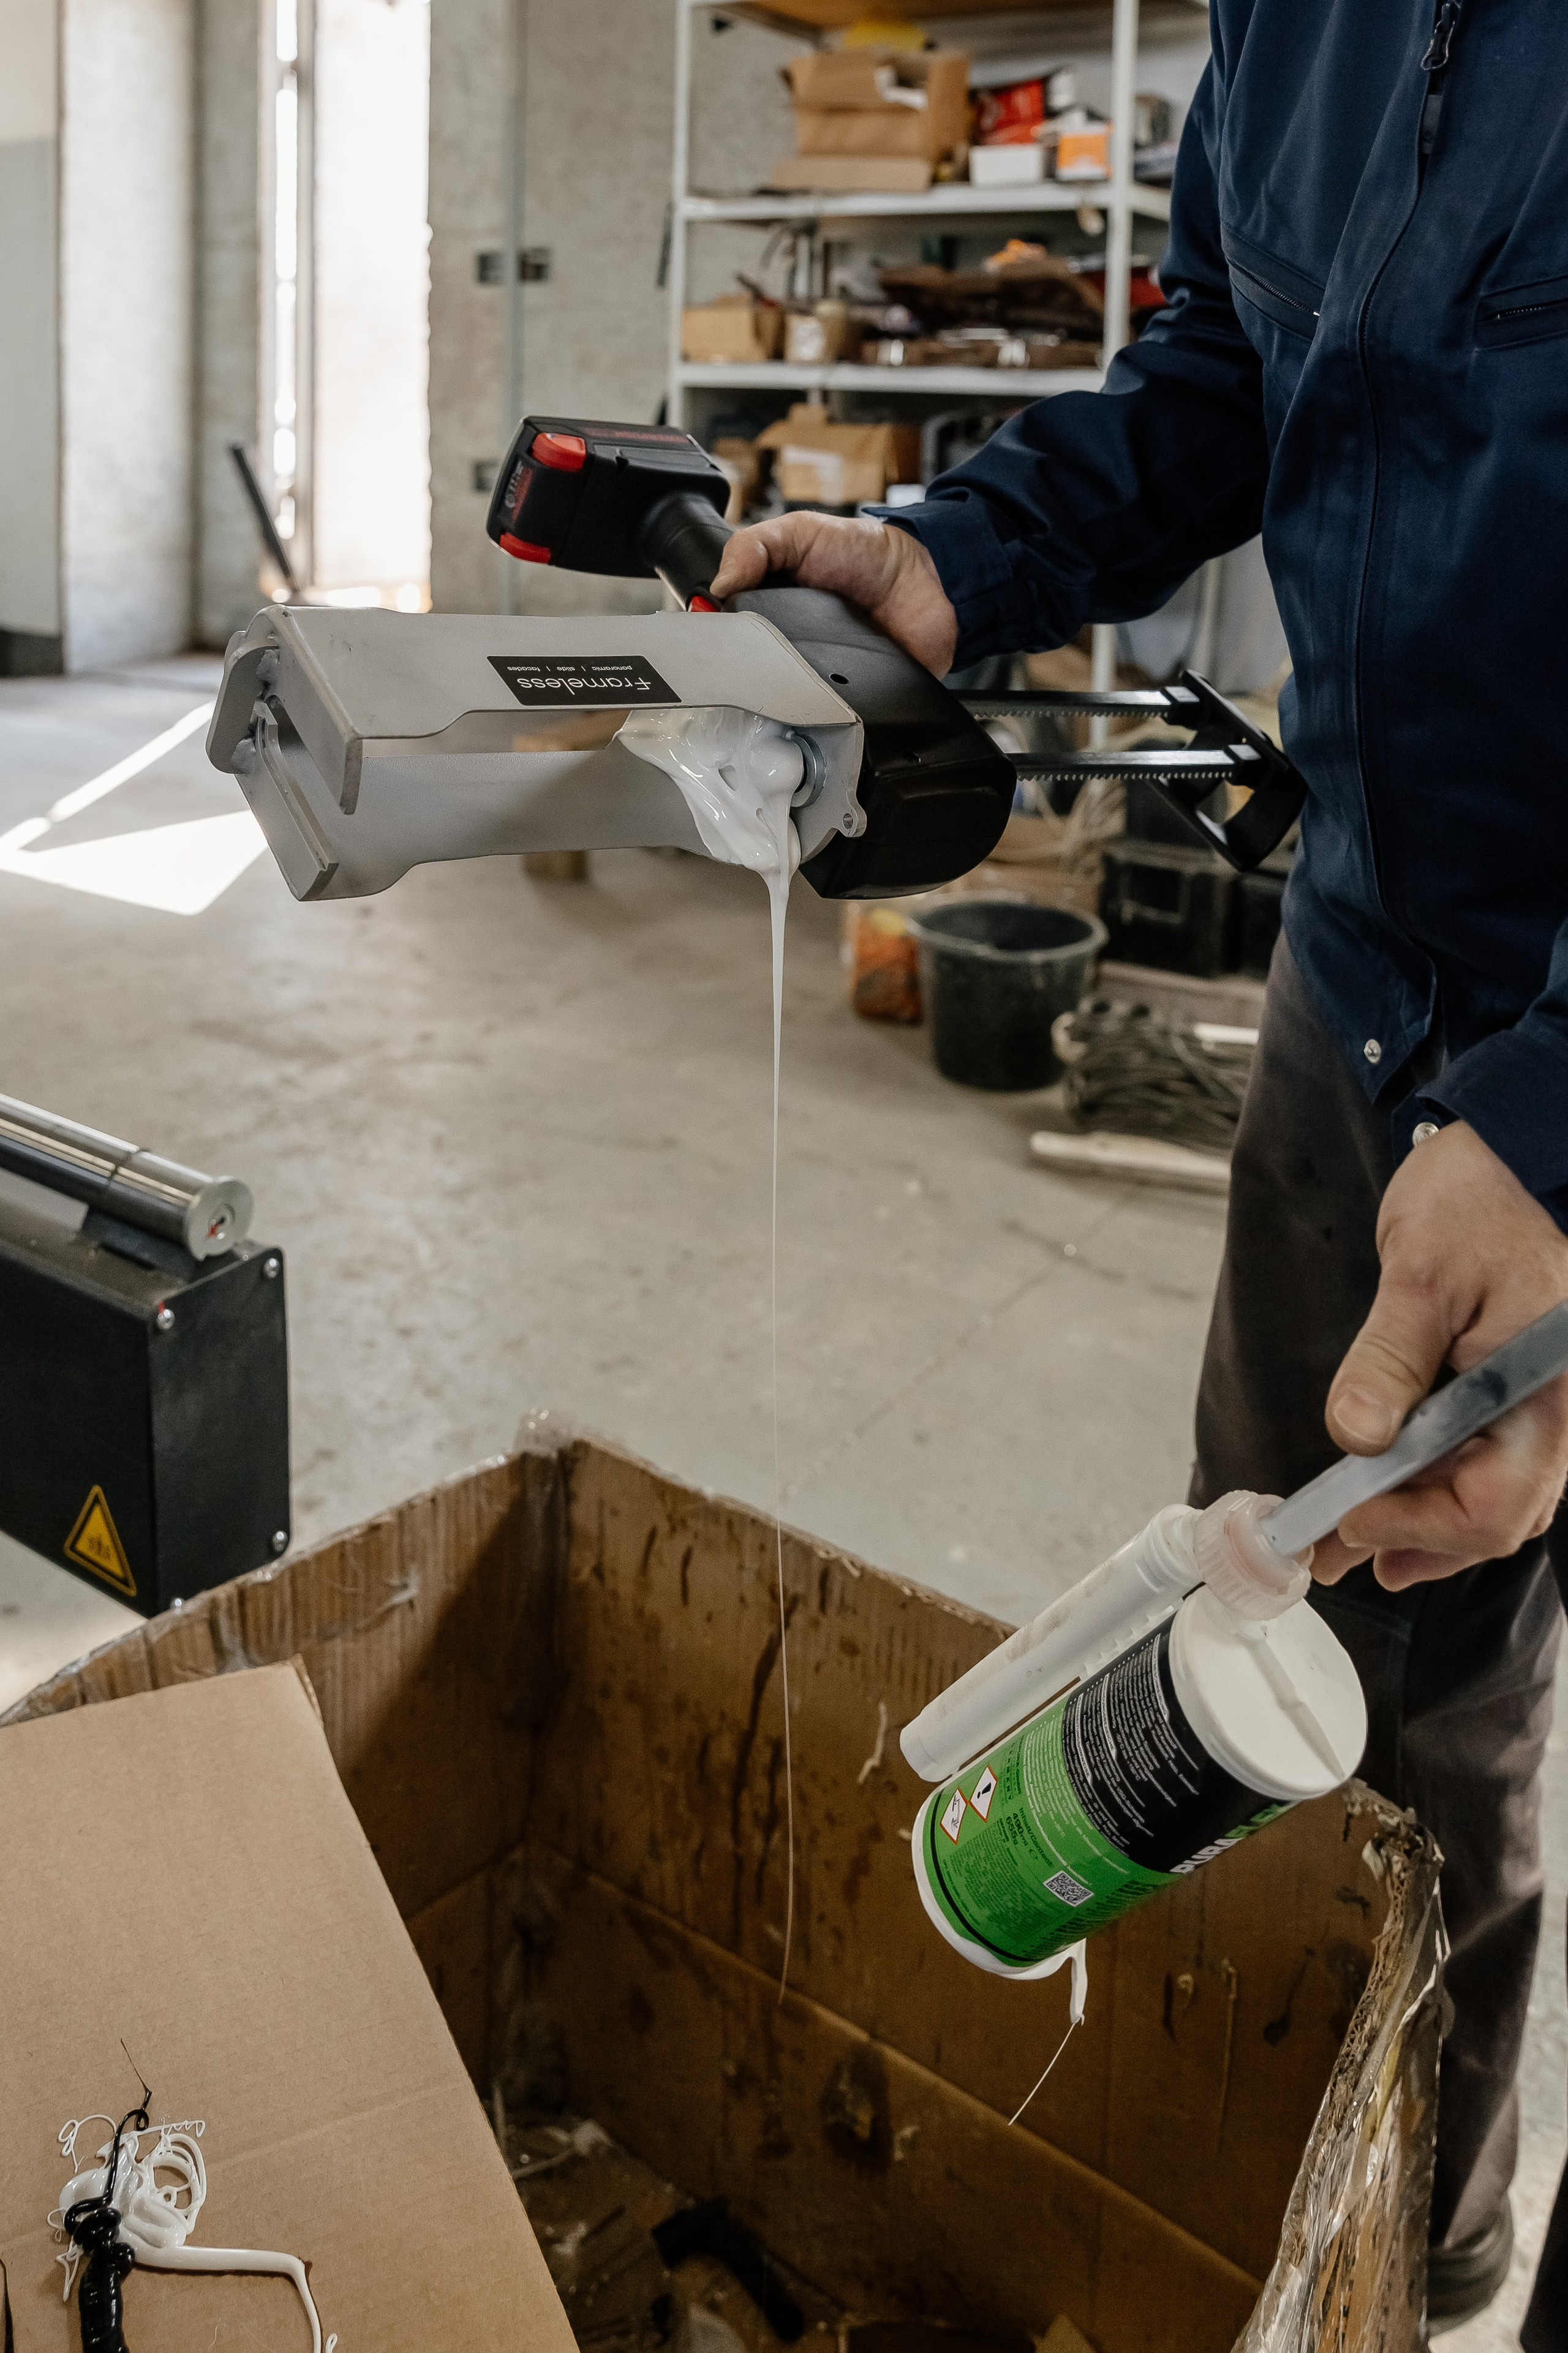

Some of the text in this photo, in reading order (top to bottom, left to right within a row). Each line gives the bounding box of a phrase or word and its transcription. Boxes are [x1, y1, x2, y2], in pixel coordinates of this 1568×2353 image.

[517, 677, 651, 695] Frameless
[1005, 1815, 1021, 1846] 655g
[1019, 1806, 1055, 1868] Inhalt/Content:
